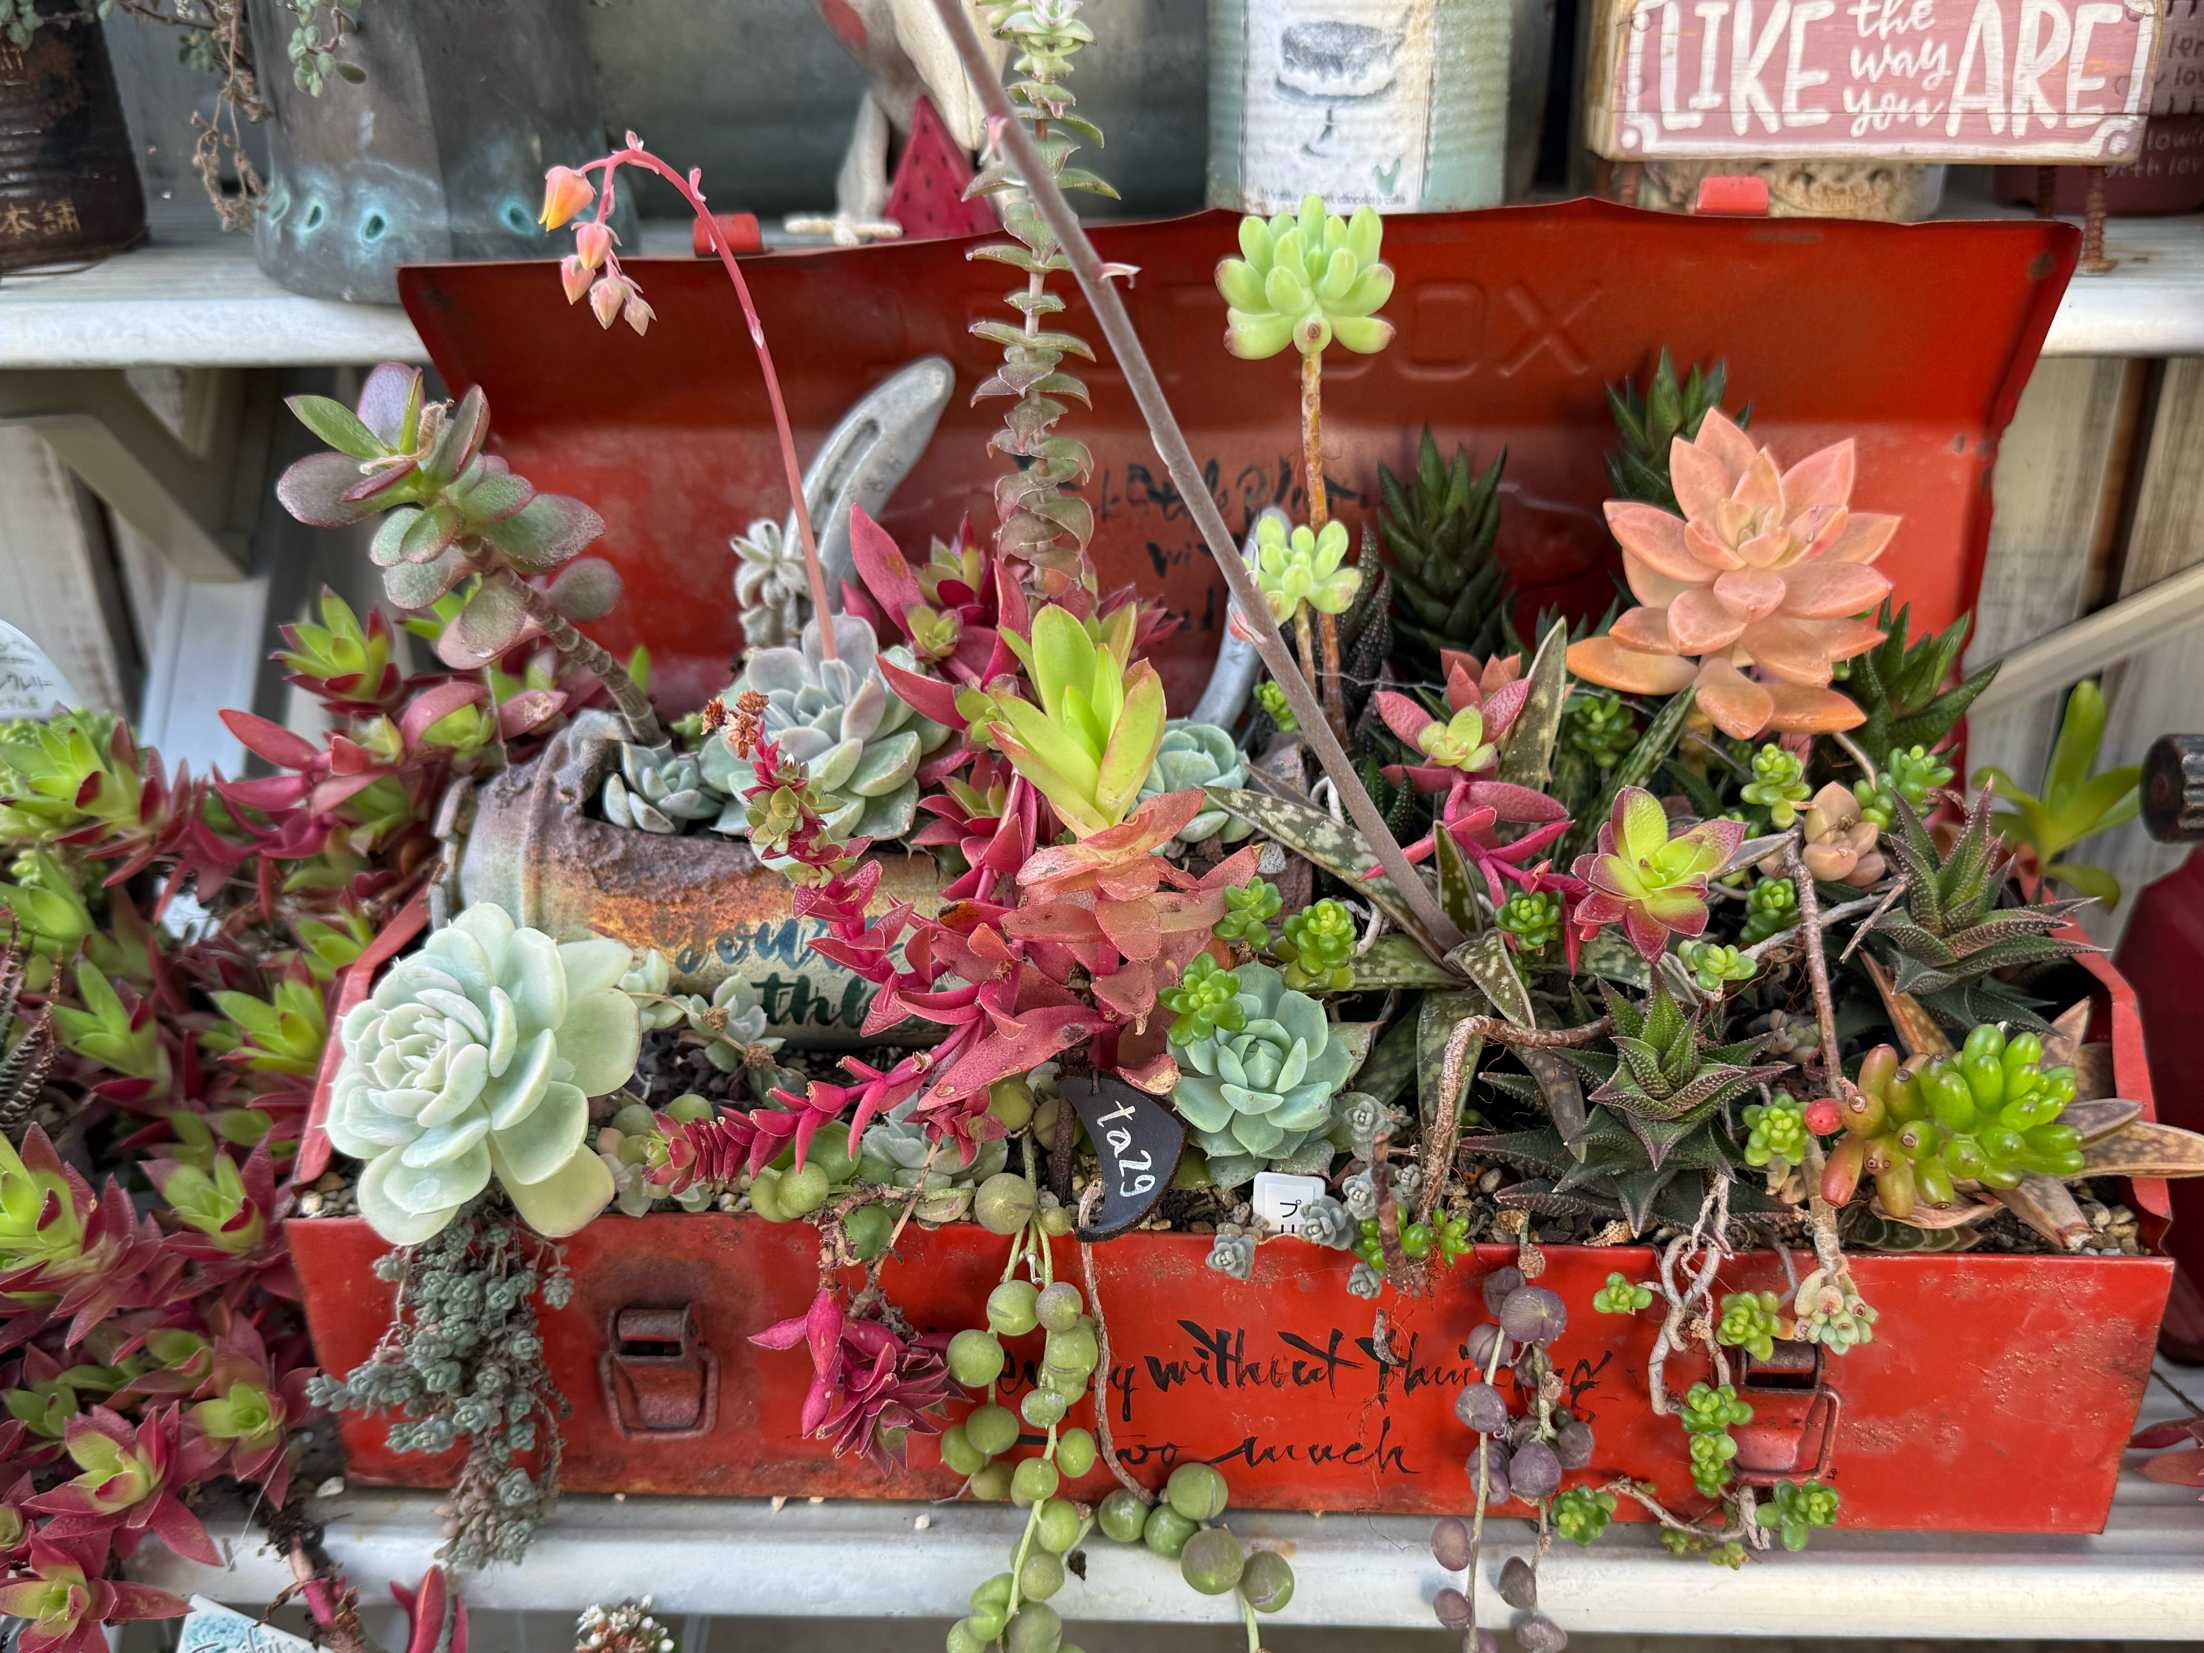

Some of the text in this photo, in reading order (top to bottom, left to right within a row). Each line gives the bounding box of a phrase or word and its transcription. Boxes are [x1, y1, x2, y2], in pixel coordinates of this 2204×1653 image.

[1846, 0, 1937, 40] the
[1661, 0, 1835, 136] LIKE
[1849, 39, 1953, 91] way
[1945, 0, 2124, 138] ARE
[1842, 86, 1946, 138] you
[1205, 1415, 1422, 1475] much
